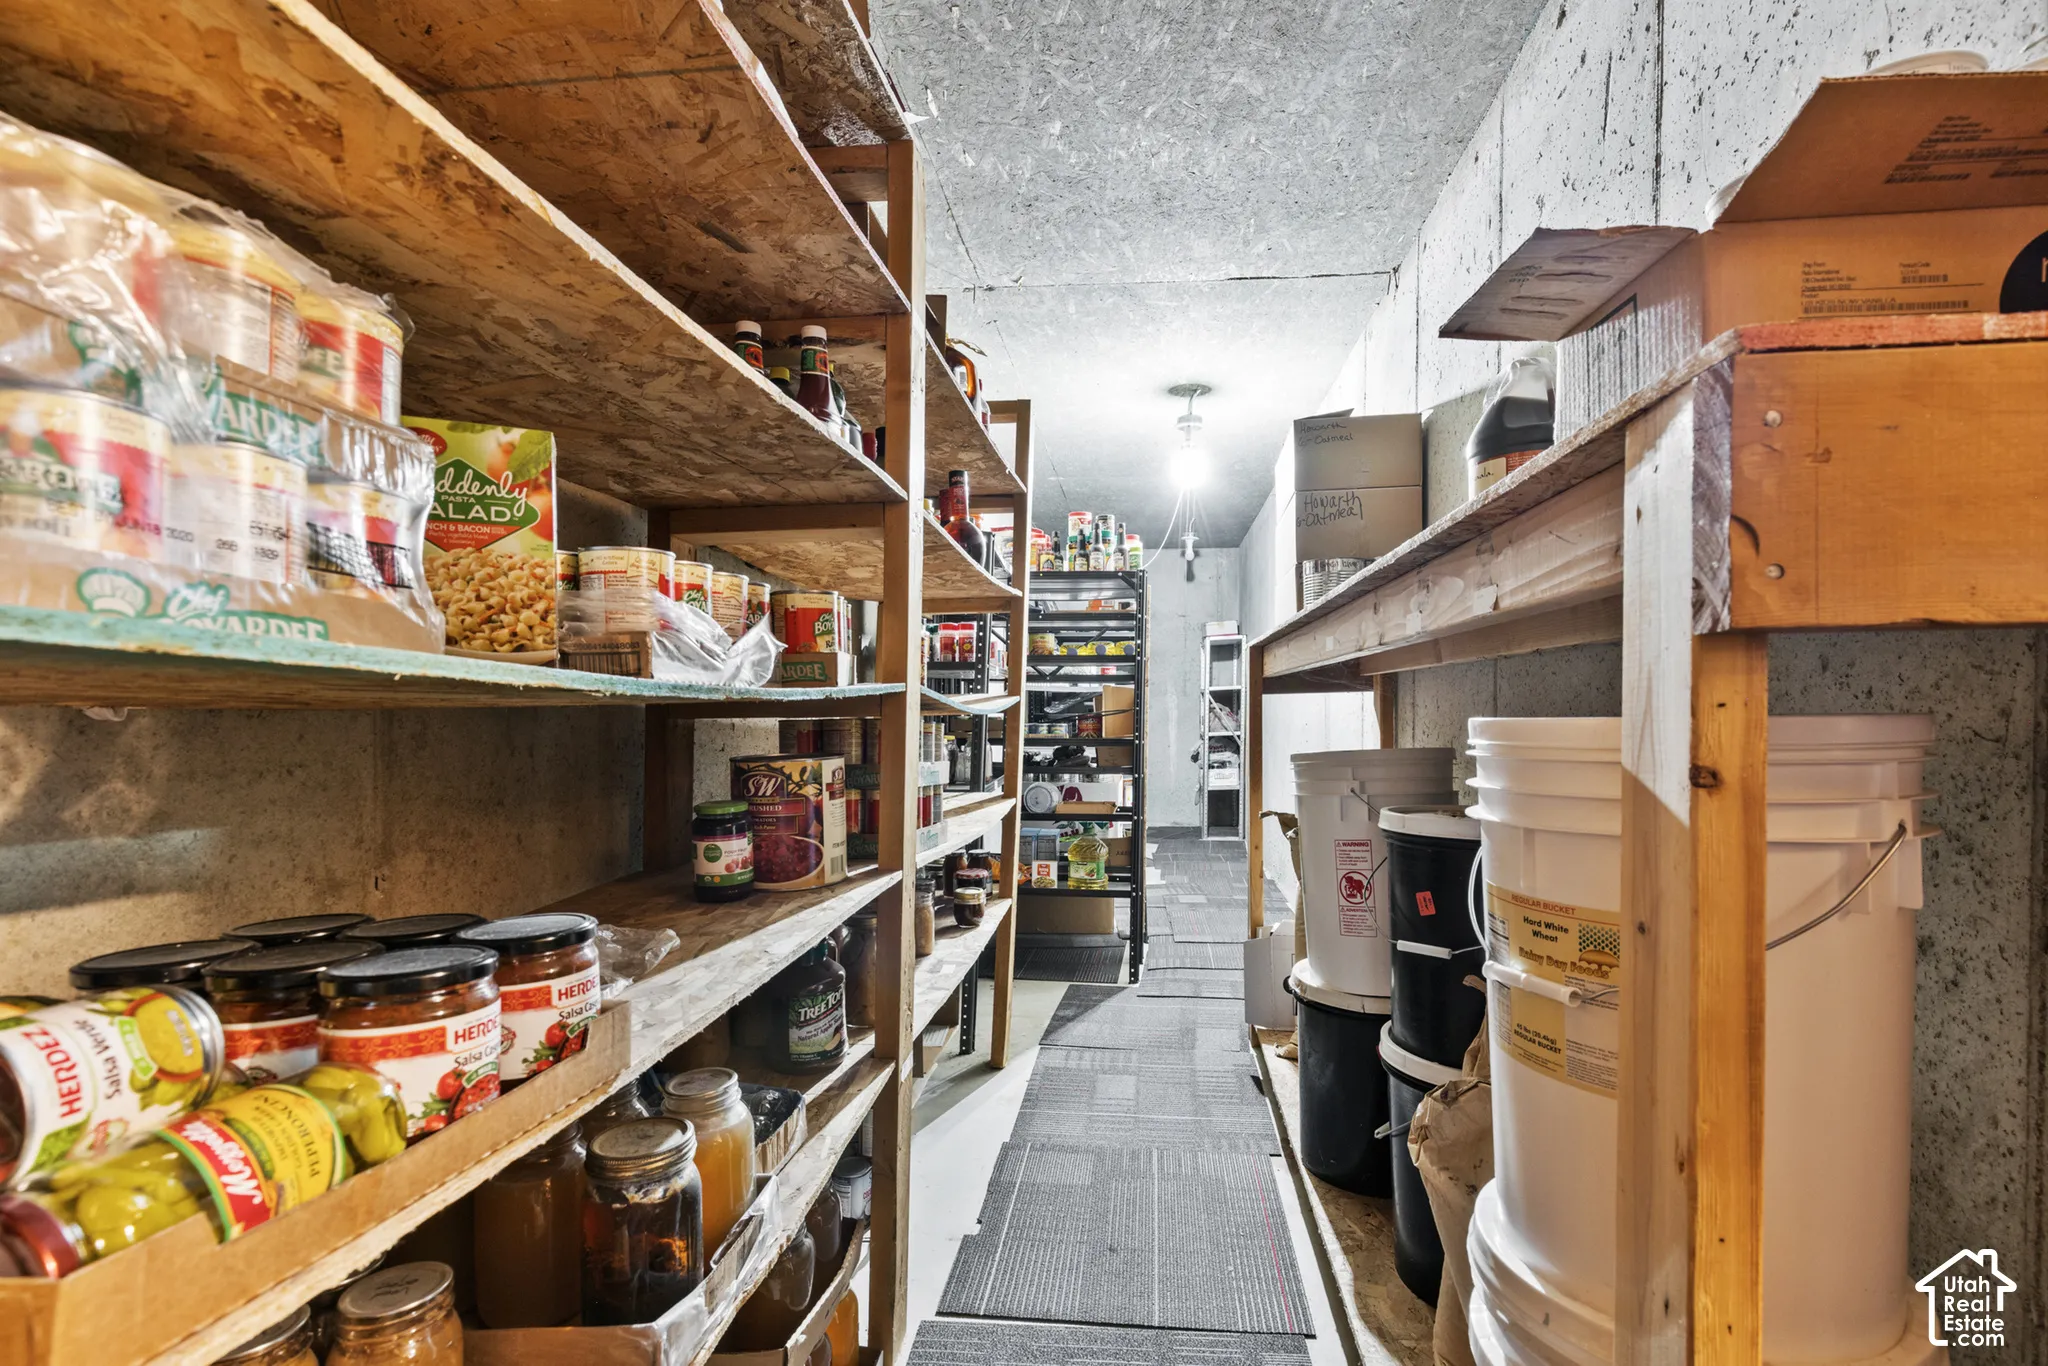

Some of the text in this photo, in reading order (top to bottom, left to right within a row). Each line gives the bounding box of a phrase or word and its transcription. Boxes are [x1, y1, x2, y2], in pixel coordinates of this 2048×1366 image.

[436, 467, 528, 518] ddenly
[441, 495, 476, 503] PASTA
[430, 501, 511, 522] ALAD
[457, 524, 491, 533] BACON
[749, 805, 782, 813] RUSHED
[1511, 894, 1576, 915] REGULAR BUCKET
[1523, 916, 1542, 928] Hard
[1544, 920, 1569, 934] White
[1532, 929, 1558, 943] Wheat
[1546, 955, 1567, 972] Day
[1570, 961, 1610, 980] Foods
[559, 1007, 584, 1022] Salsa
[454, 1015, 500, 1045] HERDE
[1514, 1029, 1561, 1054] REGULAR BUCKET
[454, 1051, 483, 1069] Salsa
[21, 1026, 83, 1119] HERDEZ
[102, 1055, 123, 1100] Salsa
